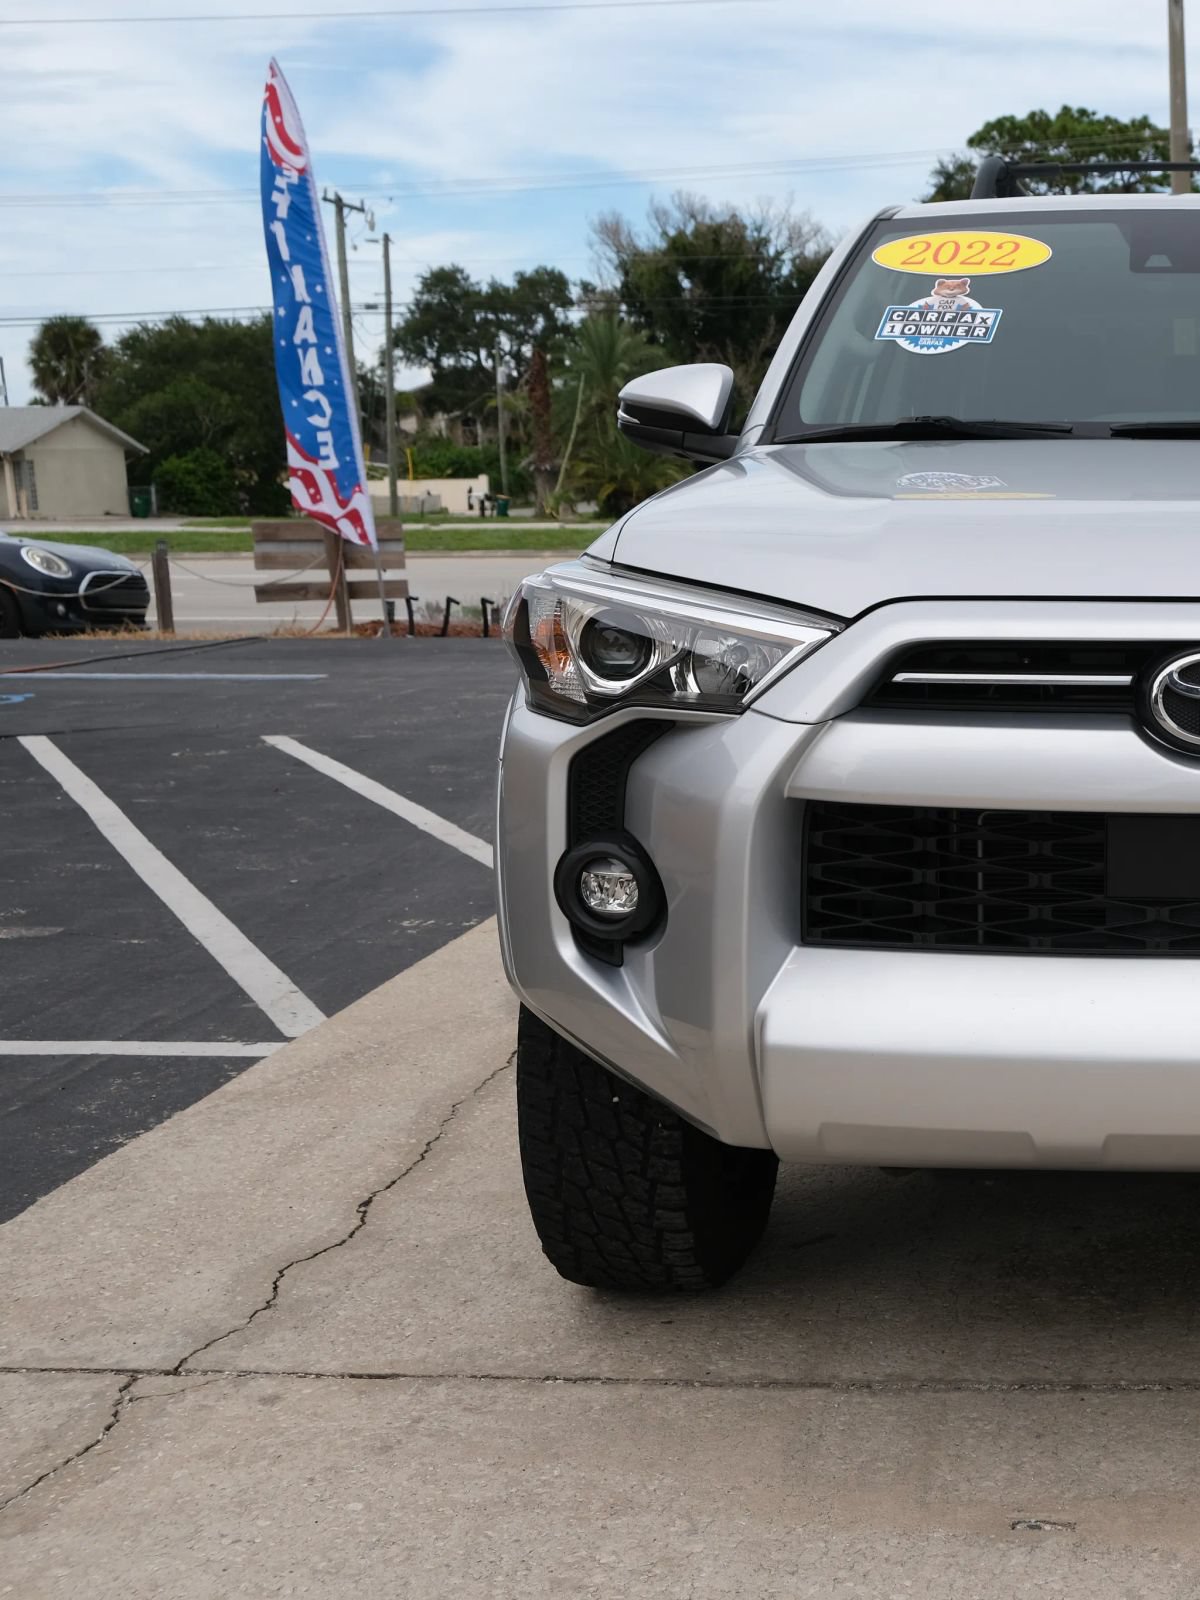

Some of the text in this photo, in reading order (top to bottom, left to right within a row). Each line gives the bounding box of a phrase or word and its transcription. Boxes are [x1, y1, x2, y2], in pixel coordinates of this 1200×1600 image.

[900, 240, 1021, 266] 2022
[892, 311, 991, 325] CARFAX
[886, 324, 986, 337] 1 OWNER
